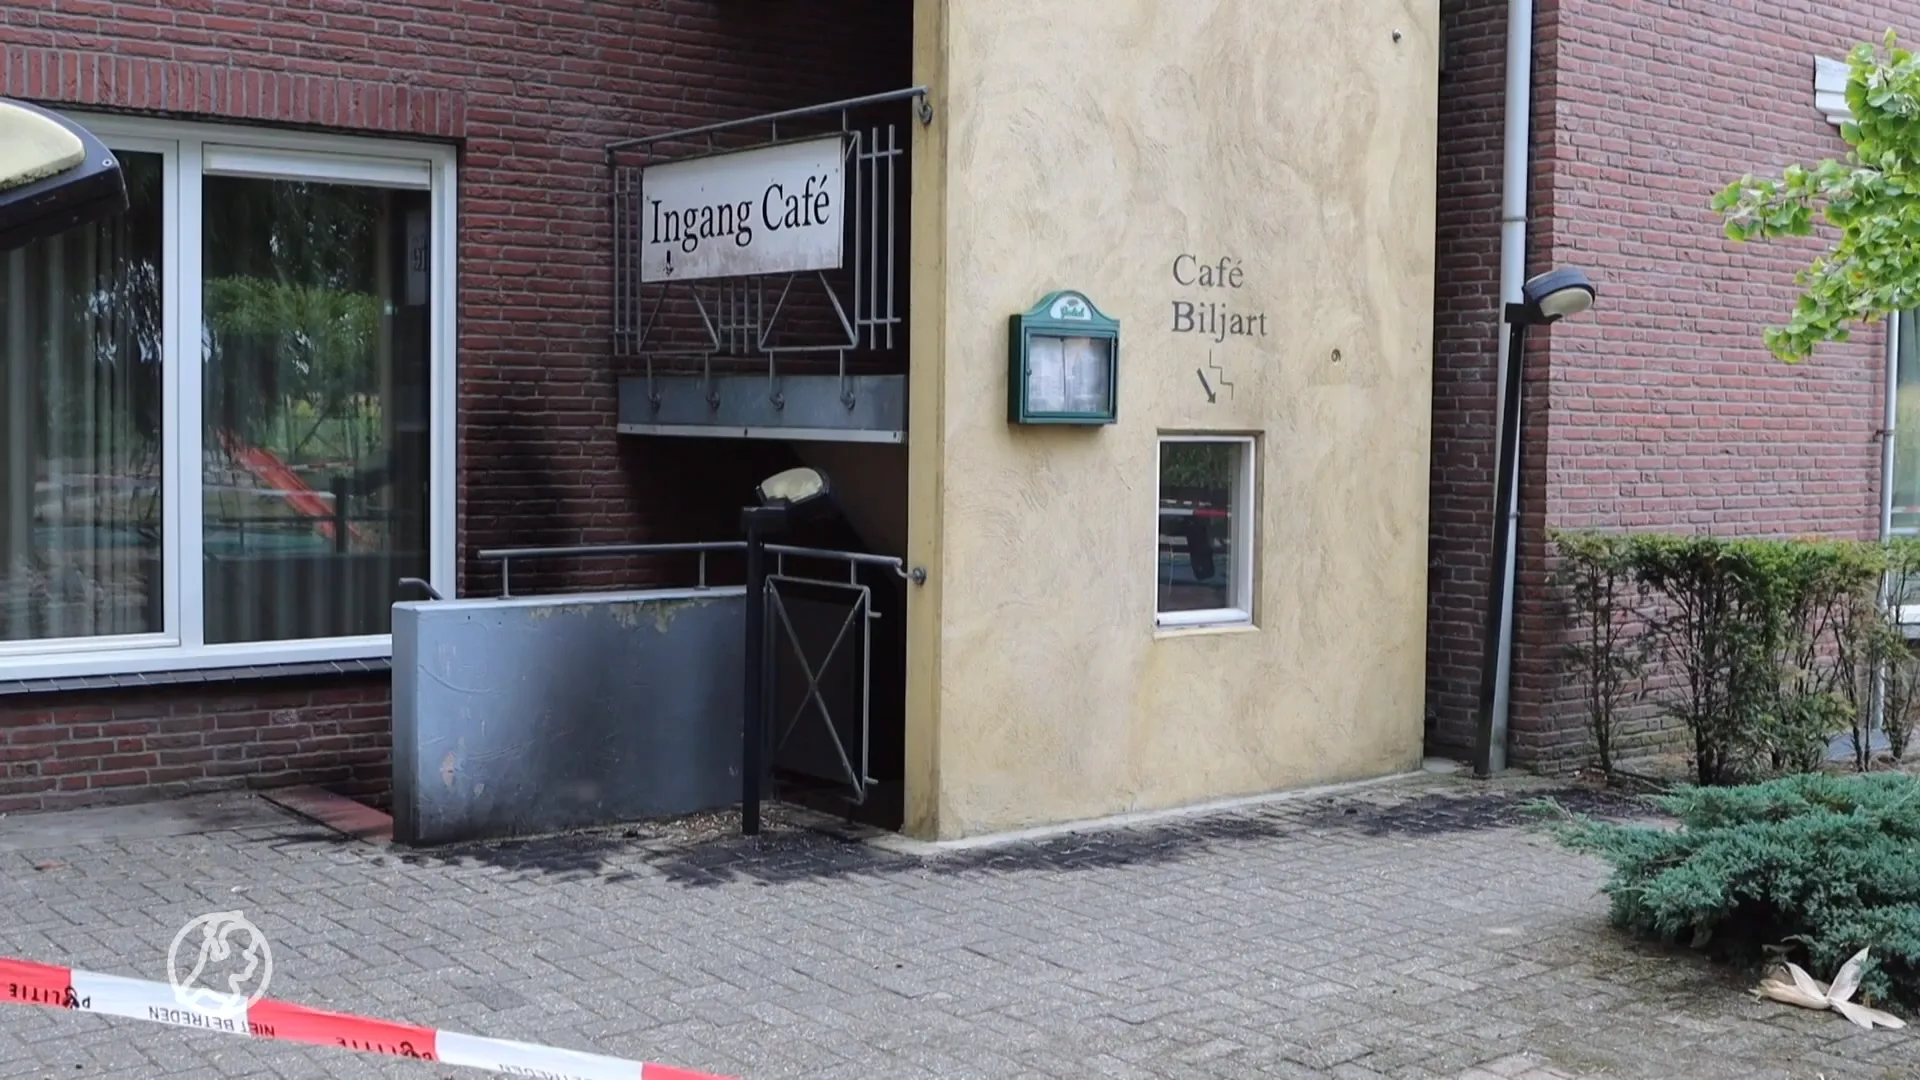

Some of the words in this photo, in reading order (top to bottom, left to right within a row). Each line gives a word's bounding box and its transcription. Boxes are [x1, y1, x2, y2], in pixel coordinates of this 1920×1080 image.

[651, 199, 753, 253] Ingang
[762, 174, 830, 231] Café
[1172, 253, 1244, 288] Café
[1171, 300, 1268, 343] Biljart
[148, 1005, 235, 1032] BETREDEN
[241, 1020, 275, 1037] NIET
